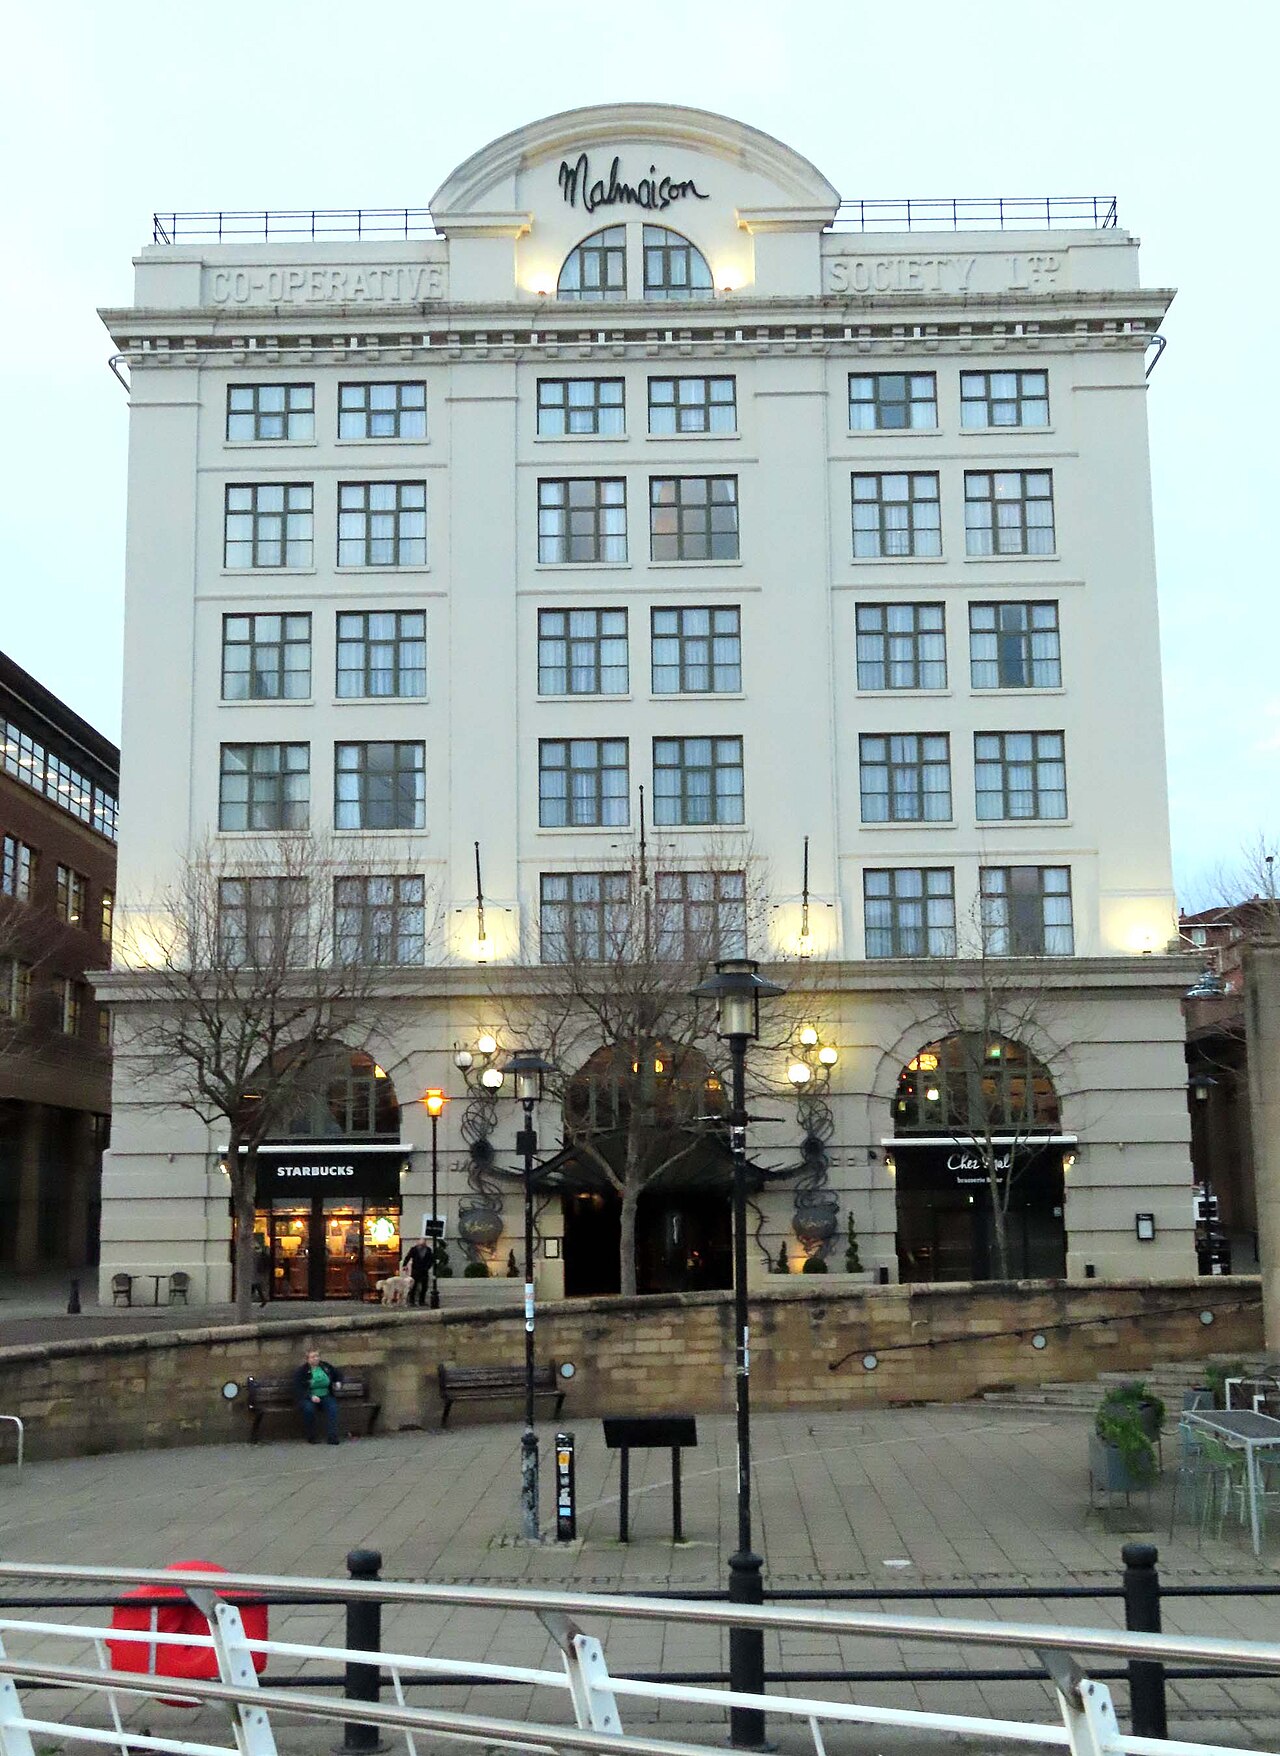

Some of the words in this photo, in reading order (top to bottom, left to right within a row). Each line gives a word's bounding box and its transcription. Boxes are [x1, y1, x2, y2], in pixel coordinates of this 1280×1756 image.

[558, 152, 710, 214] Malmaison
[212, 267, 444, 304] CO-OPERATIVE
[829, 257, 977, 293] SOCIETY
[276, 1165, 355, 1177] STARBUCKS
[947, 1153, 980, 1170] Chez
